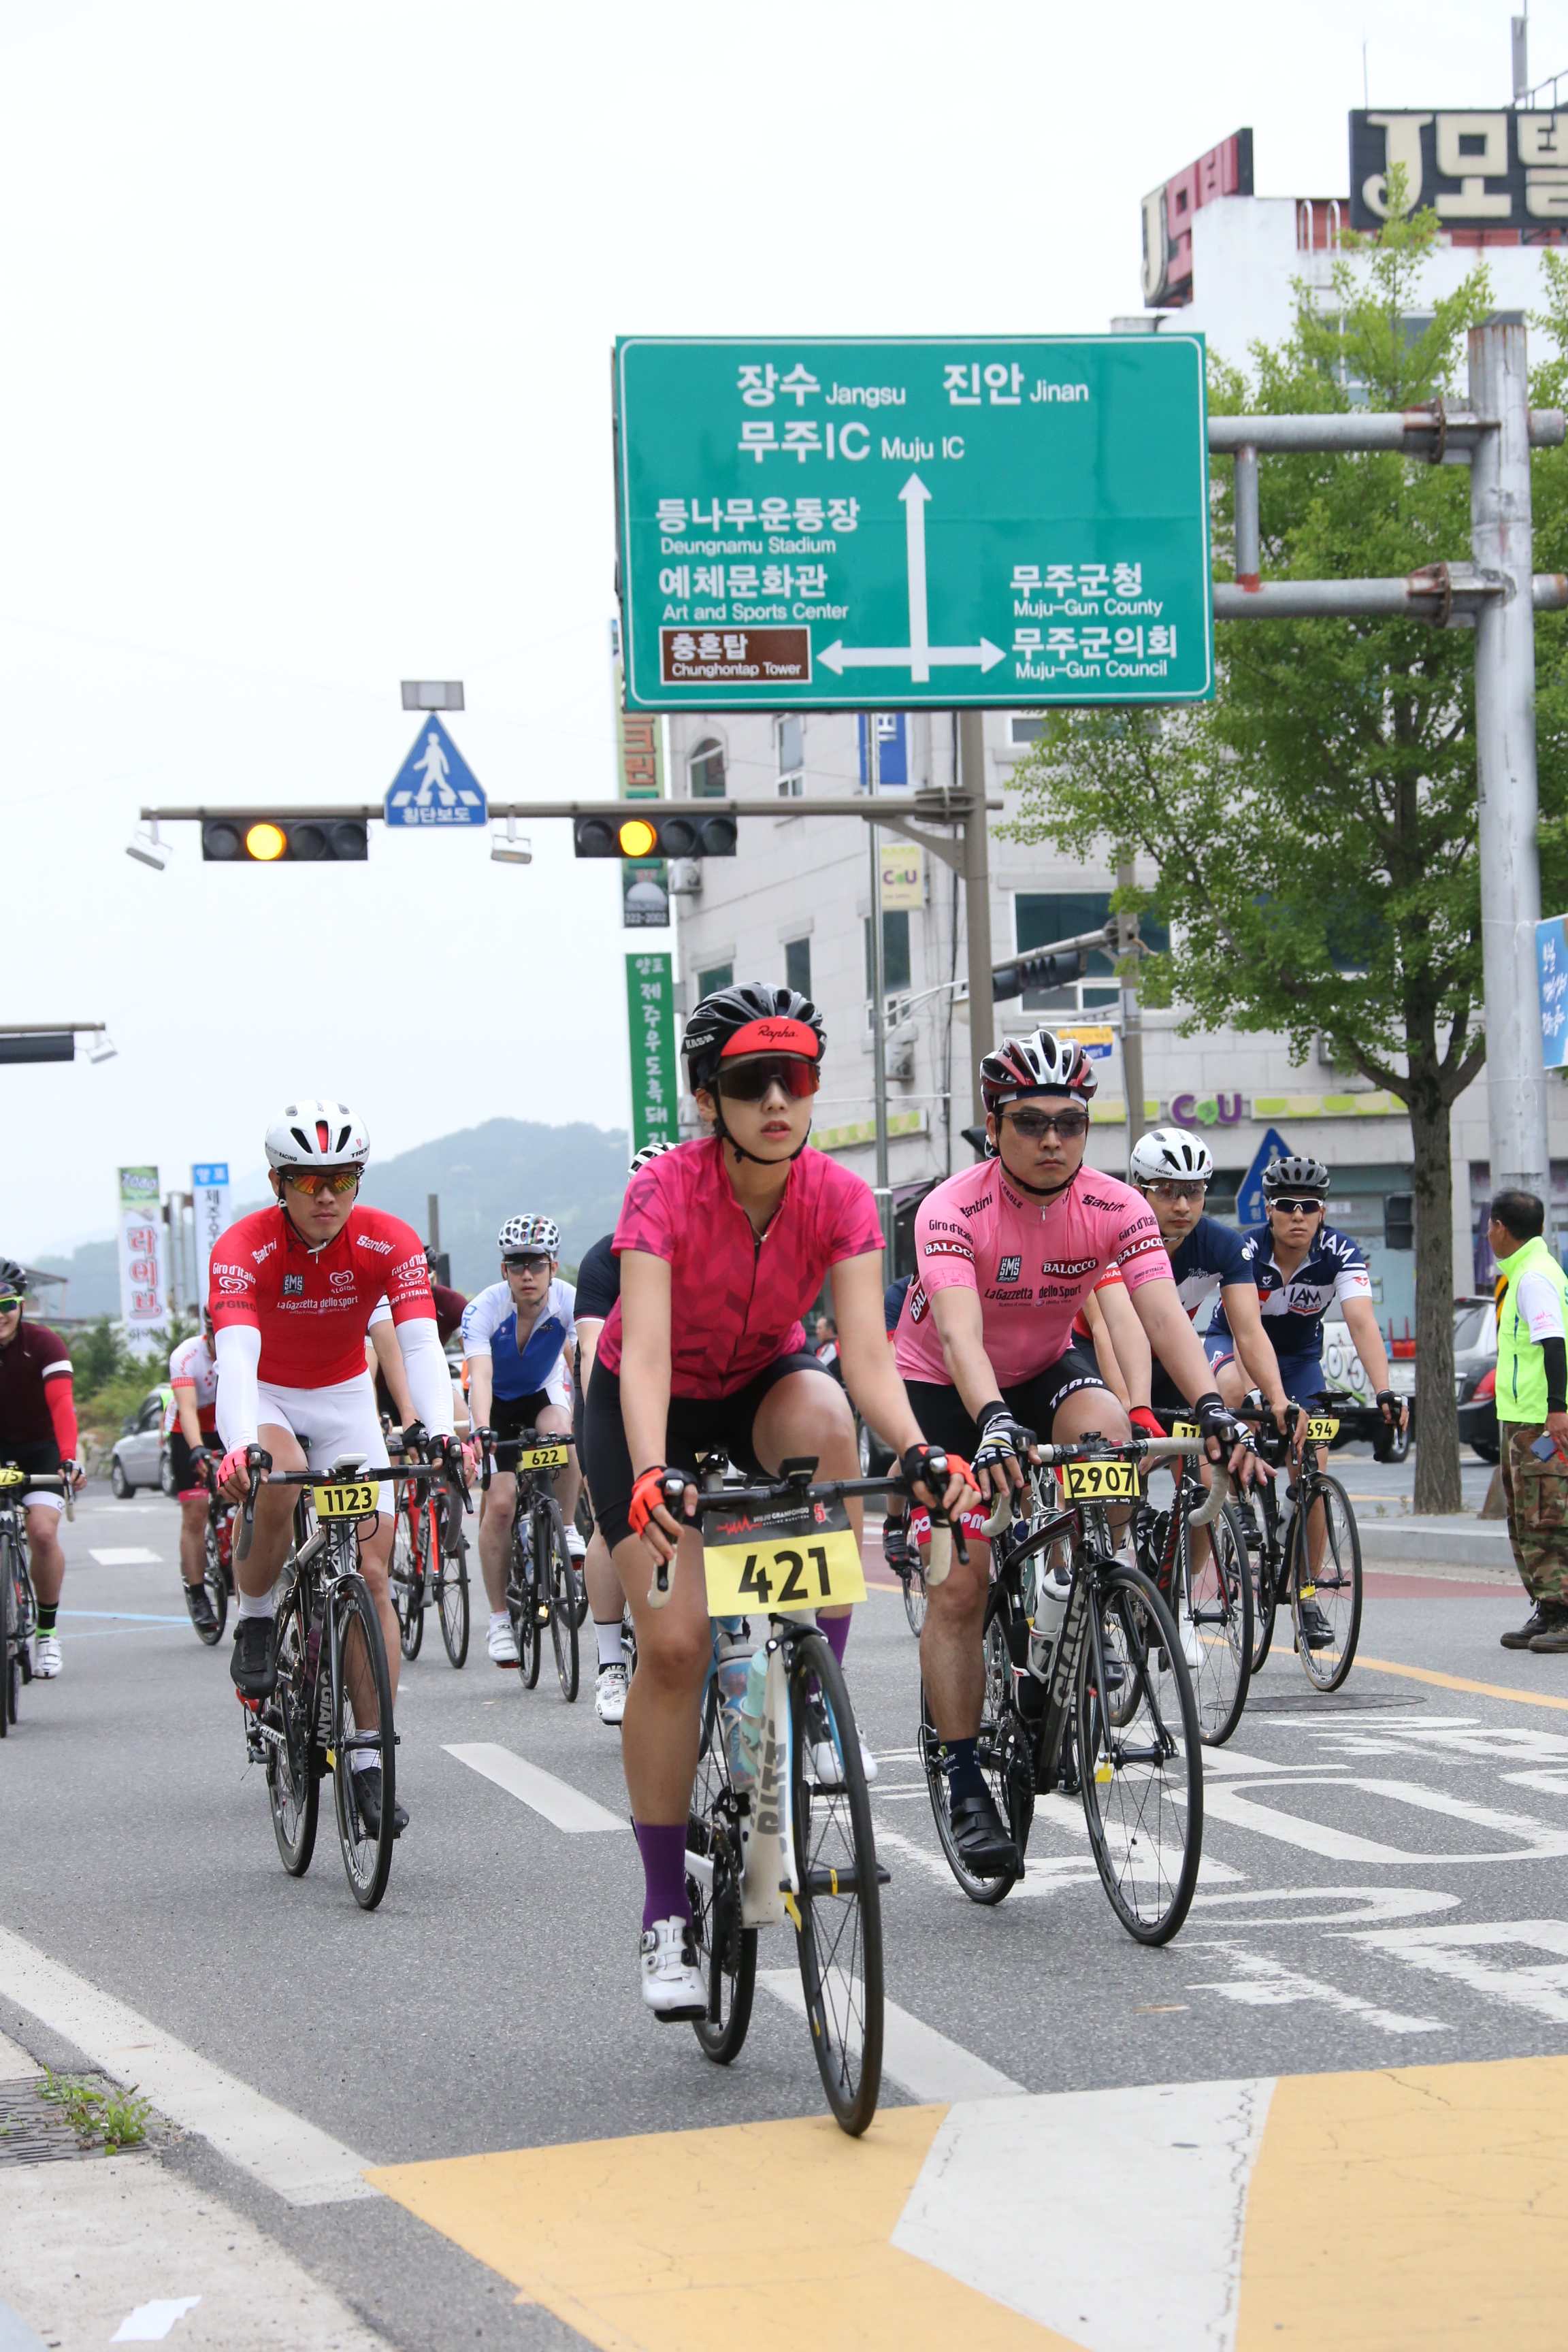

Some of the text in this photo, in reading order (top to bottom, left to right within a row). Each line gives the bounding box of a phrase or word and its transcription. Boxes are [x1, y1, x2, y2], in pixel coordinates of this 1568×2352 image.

[737, 362, 906, 407] 장수 Jangsu
[943, 363, 1088, 405] 진안 Jinan
[738, 421, 964, 463] 무주IC Muju IC
[655, 497, 859, 533] 등나무운동장
[661, 537, 835, 555] Deungnamu Stadium
[659, 564, 828, 600] 예체문화관
[1011, 563, 1143, 597] 무주군청
[664, 604, 849, 623] Art and Sports Center
[1014, 598, 1163, 618] Muju-Gun County
[671, 633, 748, 660] 충혼탑
[1012, 626, 1177, 659] 무주군의회
[672, 662, 801, 679] Chunghontap Tower
[1015, 660, 1167, 680] Muju-Gun Council
[402, 807, 471, 823] 횡단보도
[278, 1153, 297, 1162] RACING
[121, 1173, 157, 1190] 7080
[1155, 1167, 1173, 1177] RACING
[929, 1220, 947, 1230] Giro
[1118, 1224, 1137, 1241] Giro
[357, 1235, 395, 1255] Santini
[213, 1262, 256, 1285] Giro d'Italia
[1043, 1259, 1096, 1274] BALOCCO
[331, 1286, 356, 1294] ALGIDA
[985, 1284, 1081, 1301] La Gazzetta dello Sport
[1290, 1287, 1321, 1305] IAM
[215, 1300, 256, 1312] #GIRO
[286, 1299, 318, 1310] Gazzetta
[320, 1297, 338, 1307] dello
[338, 1296, 358, 1308] Sport
[1049, 1377, 1103, 1409] TEAM
[532, 1450, 559, 1465] 622
[1070, 1467, 1132, 1493] 2907
[324, 1487, 372, 1512] 1123
[738, 1546, 832, 1603] 421
[316, 1687, 332, 1750] GIANT
